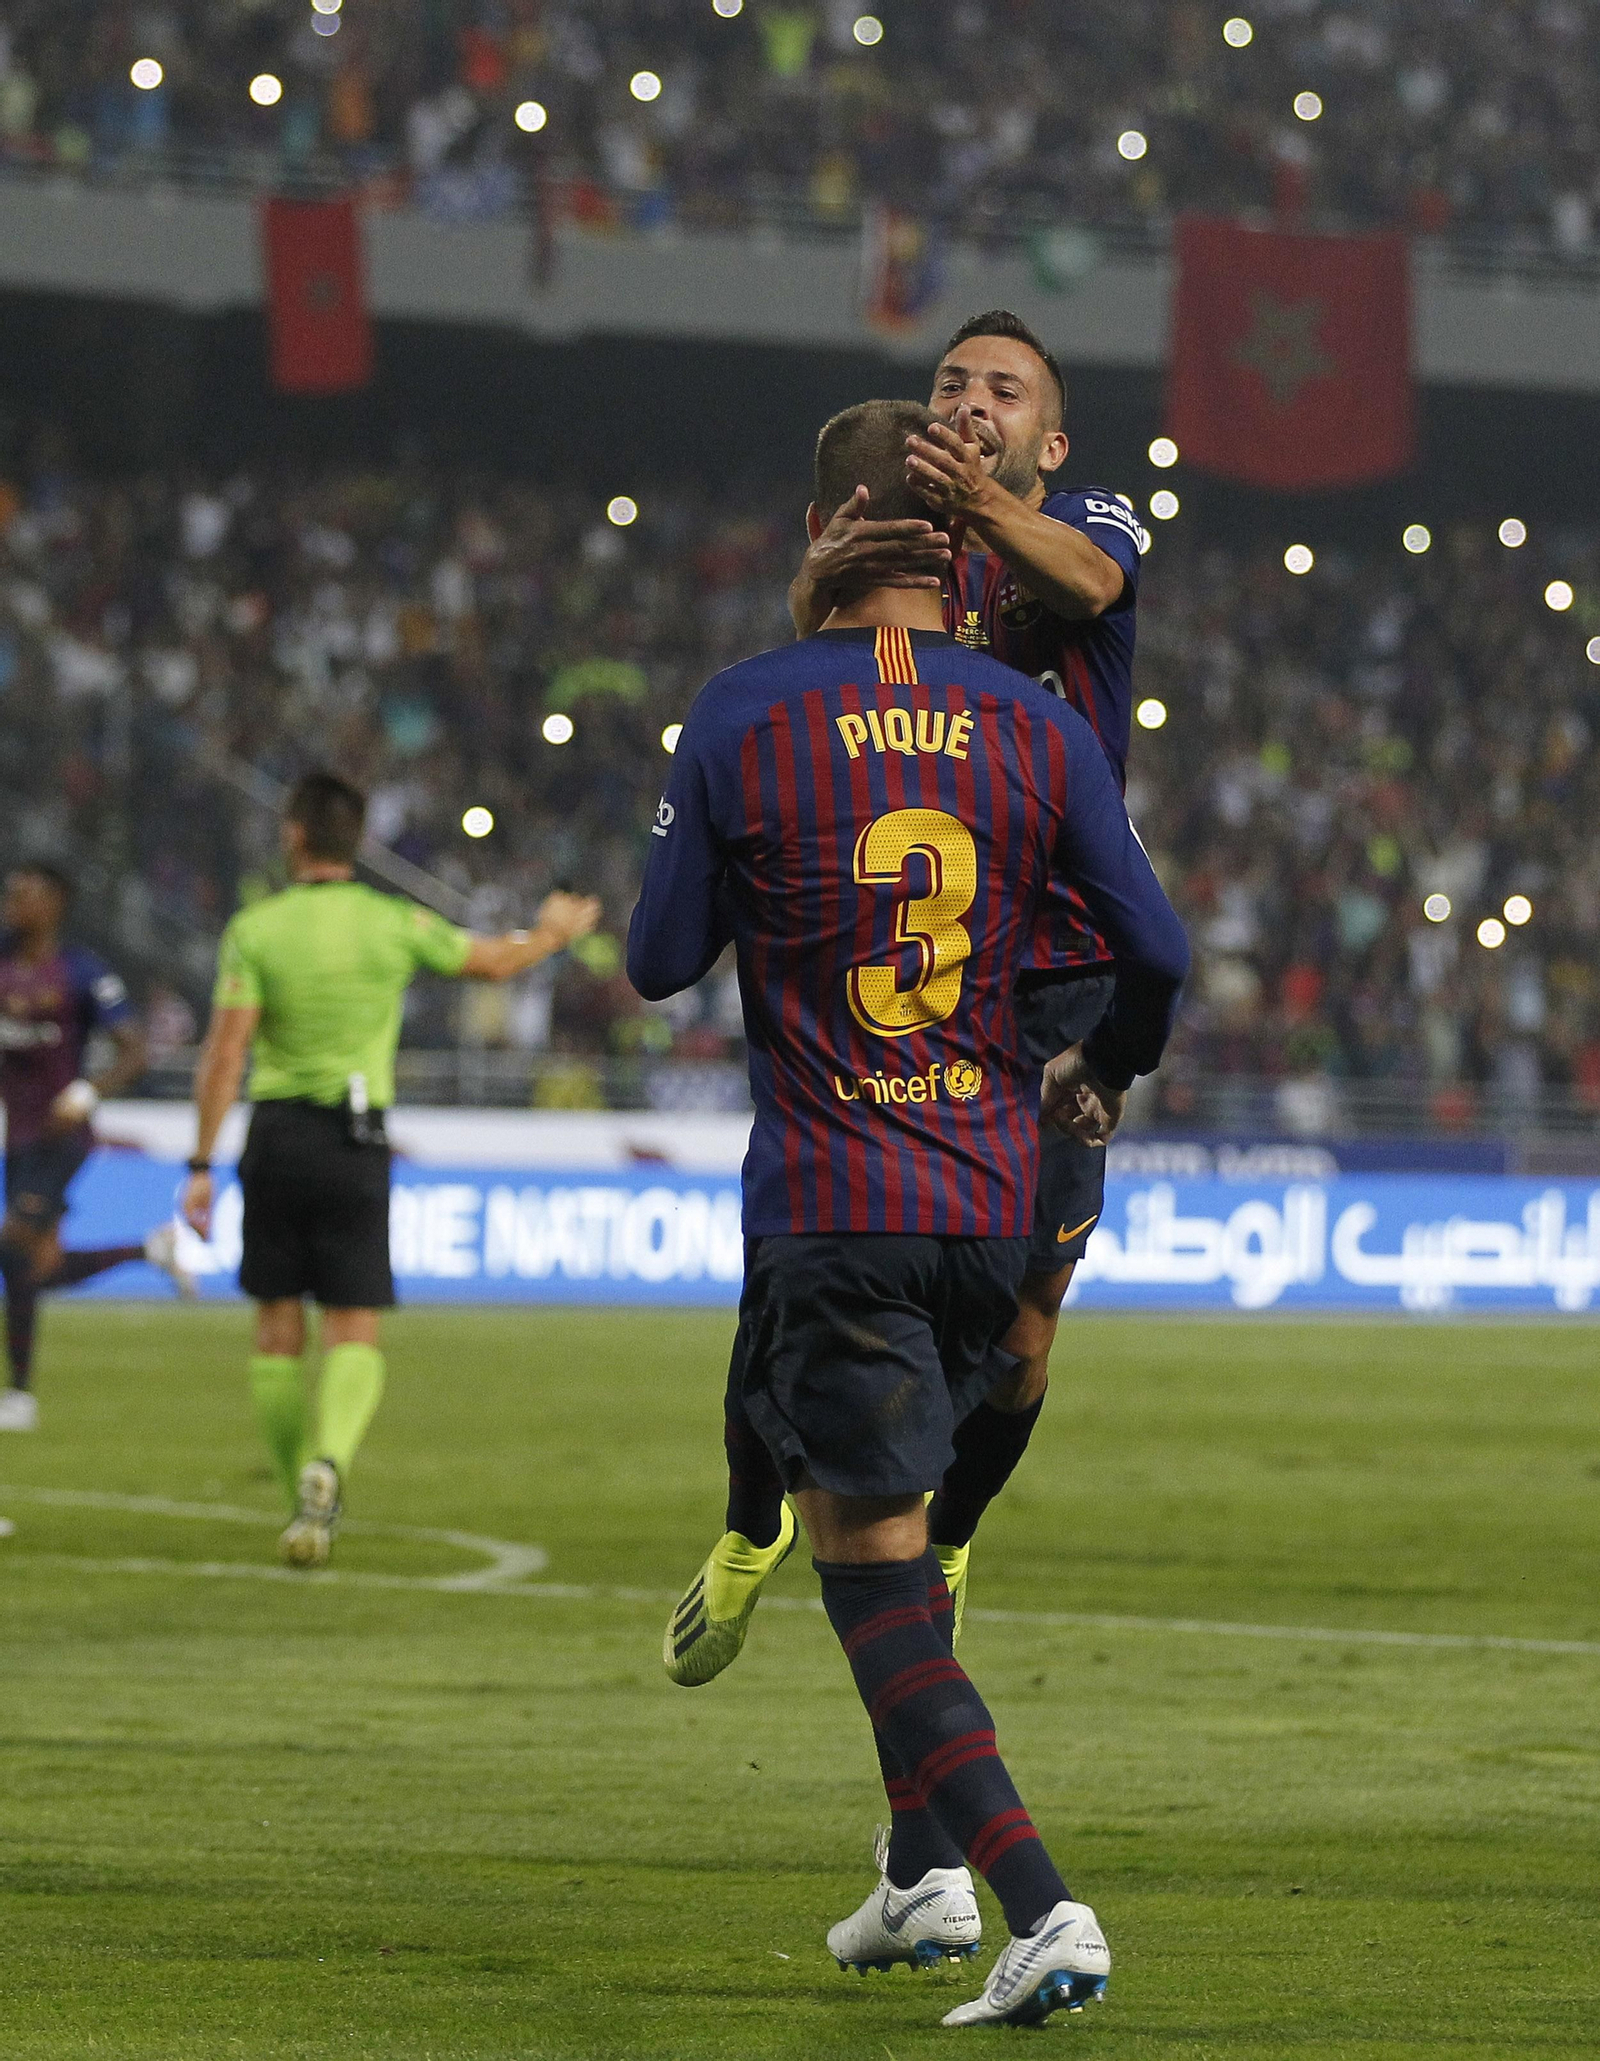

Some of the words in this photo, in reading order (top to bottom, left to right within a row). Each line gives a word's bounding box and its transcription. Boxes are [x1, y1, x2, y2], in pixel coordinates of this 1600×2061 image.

[835, 708, 975, 760] PIQUÉ
[847, 808, 977, 1037] 3
[834, 1063, 941, 1104] unicef
[942, 1914, 977, 1923] TIEMPO
